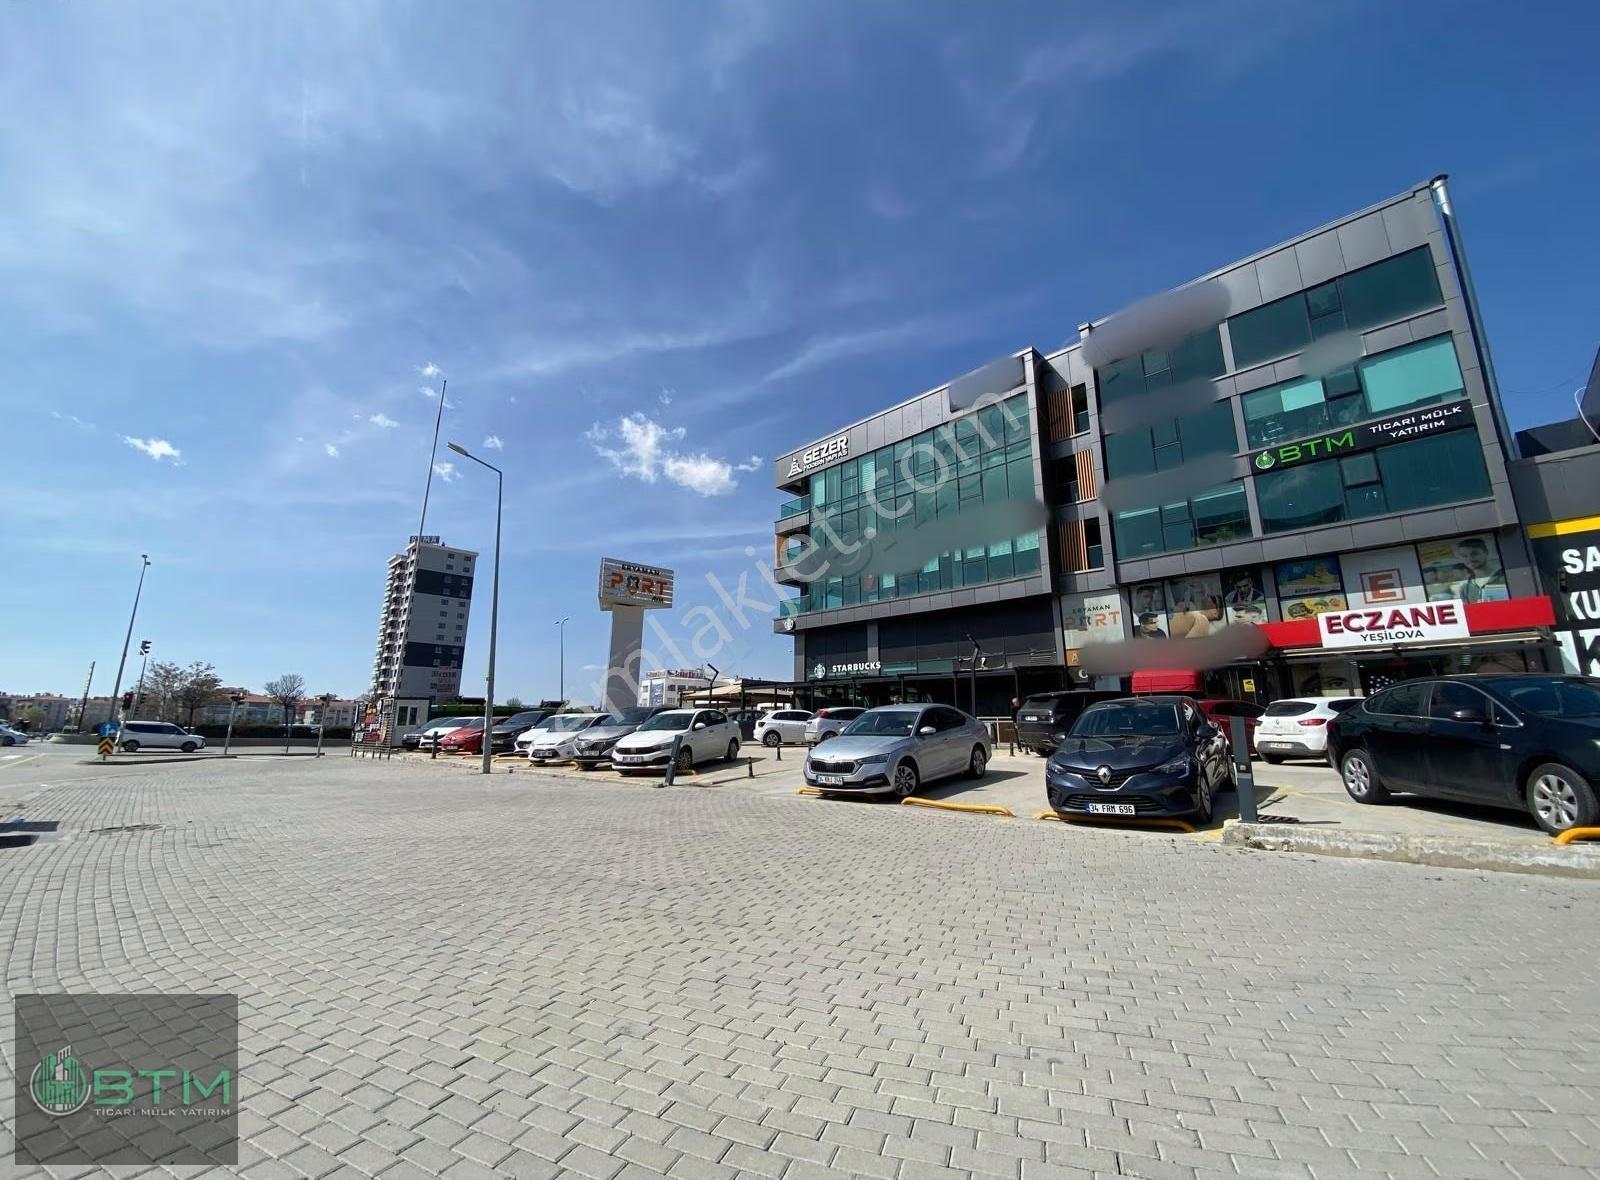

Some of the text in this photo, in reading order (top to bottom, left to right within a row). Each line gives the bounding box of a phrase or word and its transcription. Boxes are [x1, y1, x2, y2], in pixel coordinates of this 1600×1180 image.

[1421, 405, 1462, 421] MÜLK
[1389, 419, 1445, 438] YATIRIM
[803, 436, 848, 464] GEZER
[1279, 432, 1355, 464] BTM
[621, 563, 660, 576] ERYAMAN
[611, 571, 667, 596] PORT
[1325, 604, 1458, 635] ECZANE
[1360, 629, 1425, 643] YEŞİLOVA
[832, 661, 881, 673] STARBUCKS
[1090, 804, 1099, 812] 34
[1119, 805, 1133, 814] 696
